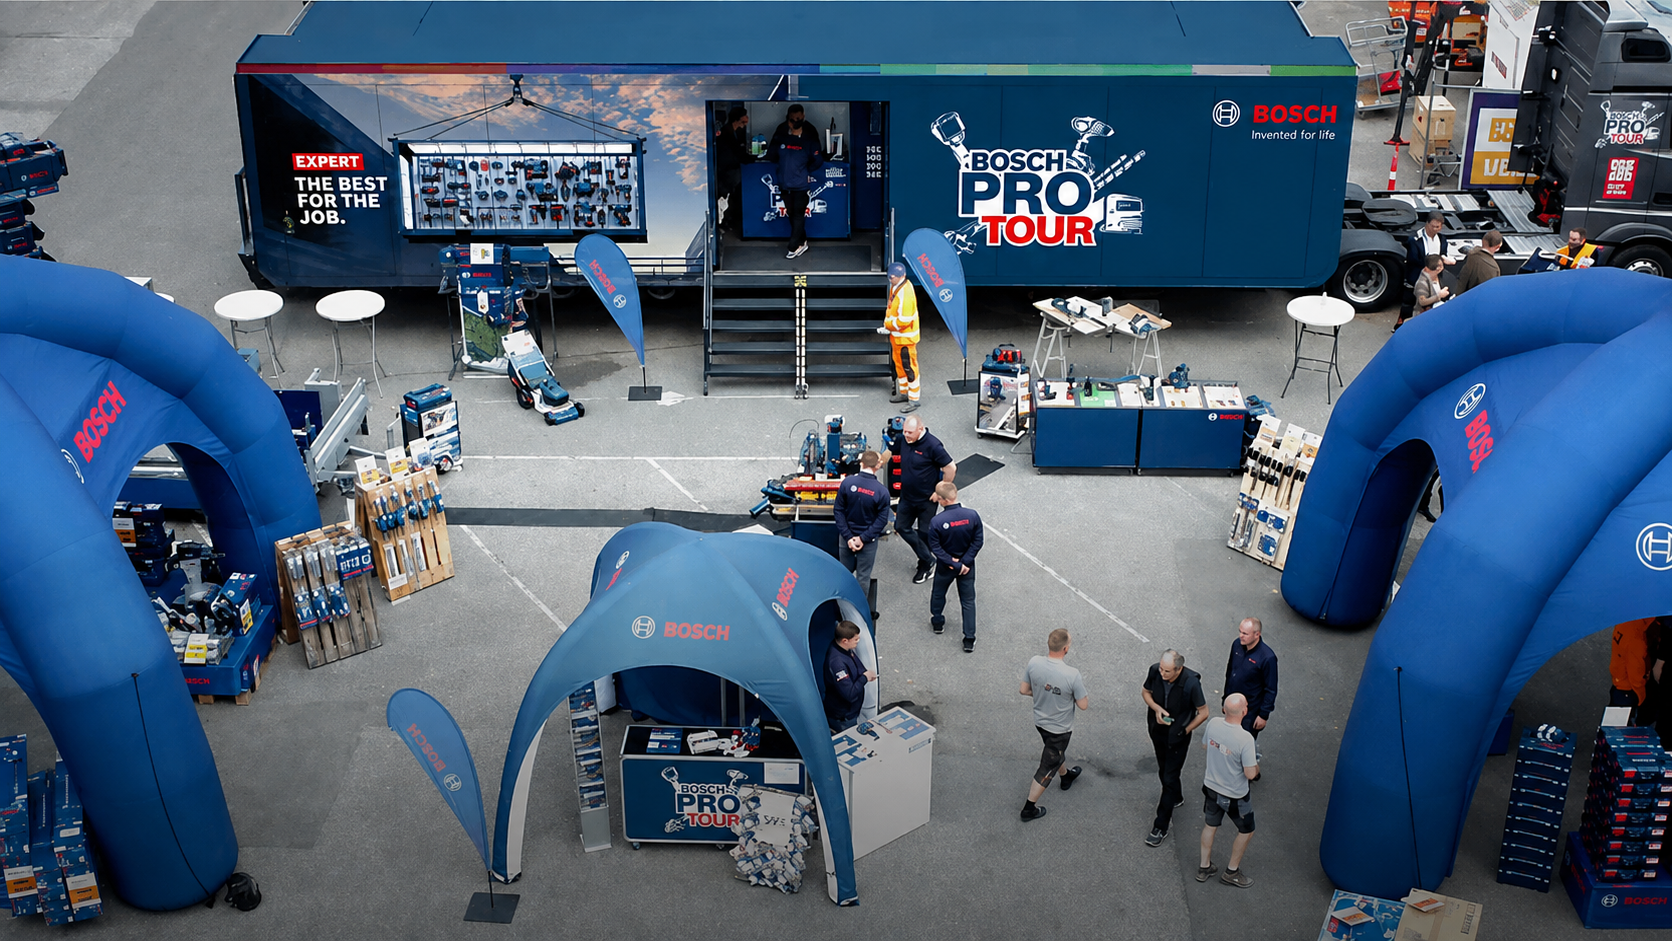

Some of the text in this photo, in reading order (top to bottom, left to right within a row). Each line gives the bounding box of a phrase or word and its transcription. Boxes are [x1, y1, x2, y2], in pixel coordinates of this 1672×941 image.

[1253, 104, 1338, 124] BOSCH
[1251, 129, 1336, 140] Invented for life
[1605, 120, 1645, 134] PRO
[1611, 133, 1644, 144] TOUR
[295, 155, 360, 168] EXPERT
[971, 151, 1064, 172] BOSCH
[294, 176, 388, 192] THE BEST
[961, 171, 1092, 215] PRO
[297, 193, 381, 208] FOR THE
[299, 210, 347, 225] JOB.
[981, 215, 1094, 245] TOUR
[73, 380, 127, 463] BOSCH
[1464, 409, 1494, 474] BOS
[776, 567, 799, 608] BOSCH
[663, 621, 731, 641] BOSCH
[407, 723, 446, 772] BOSCH
[680, 784, 726, 795] BOSCH
[676, 794, 741, 814] PRO
[686, 813, 740, 827] TOUR
[1624, 897, 1668, 905] BOSCH
